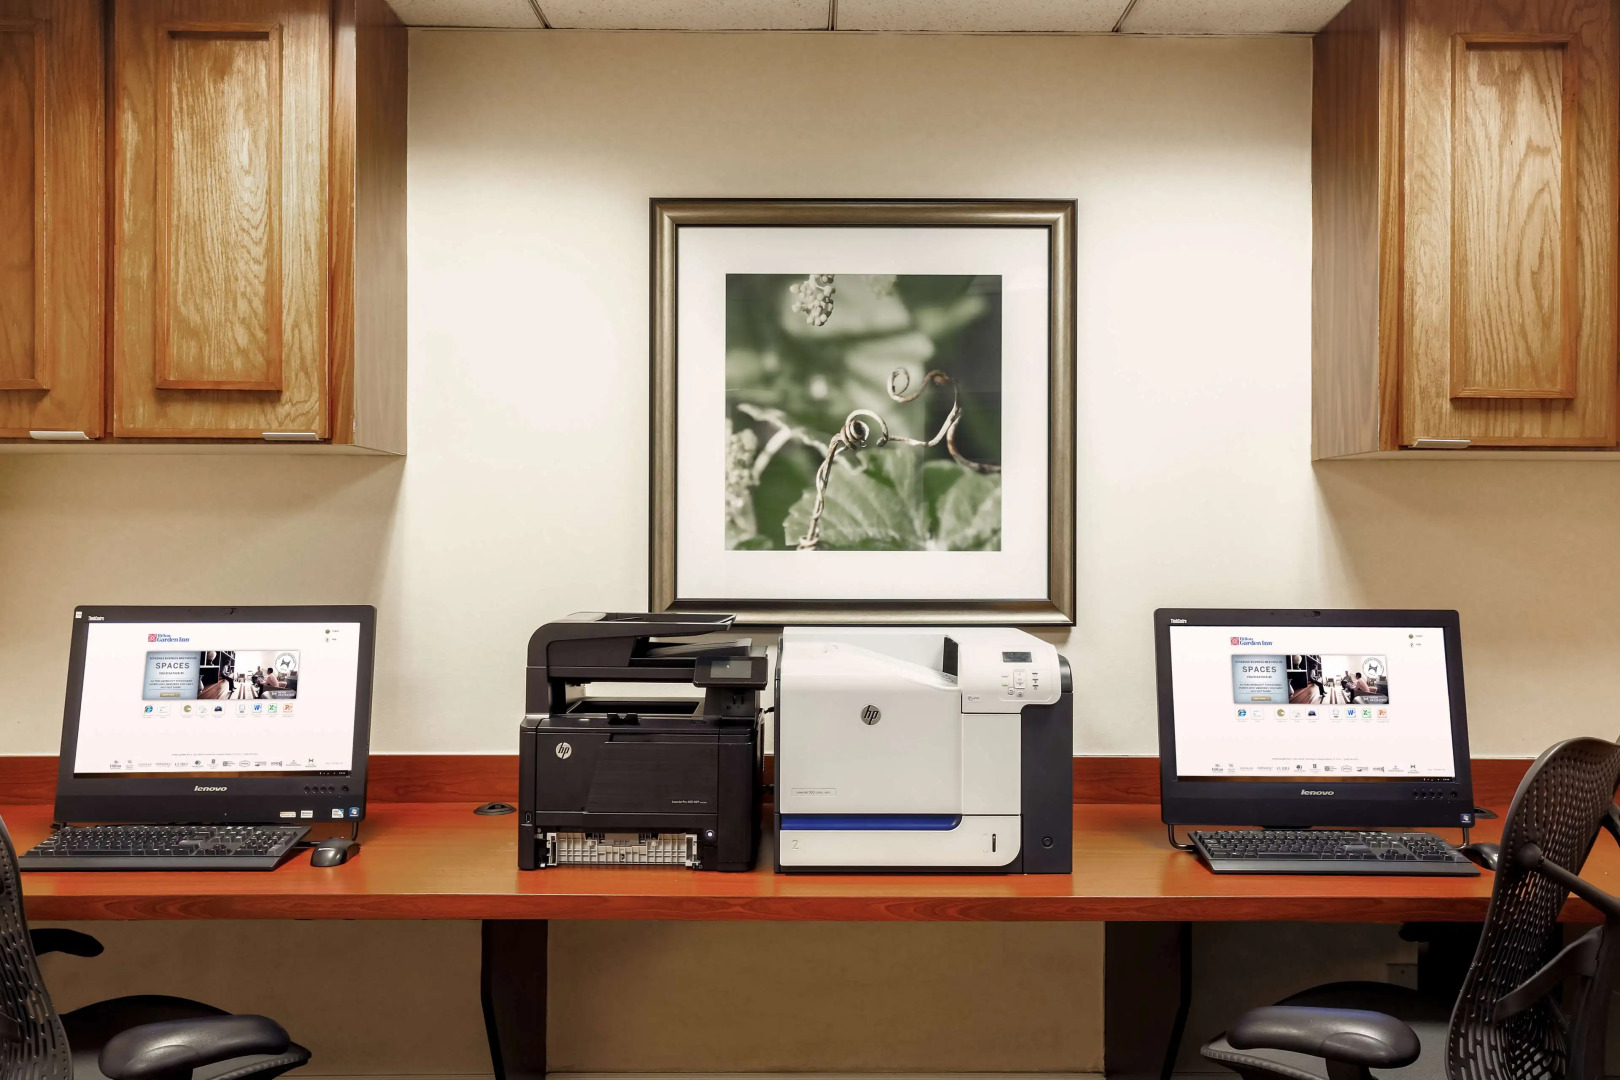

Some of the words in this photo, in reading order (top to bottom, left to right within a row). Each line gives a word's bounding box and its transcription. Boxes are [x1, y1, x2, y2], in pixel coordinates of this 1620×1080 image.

[863, 704, 879, 725] hp
[557, 742, 570, 759] hp
[792, 840, 799, 850] 2
